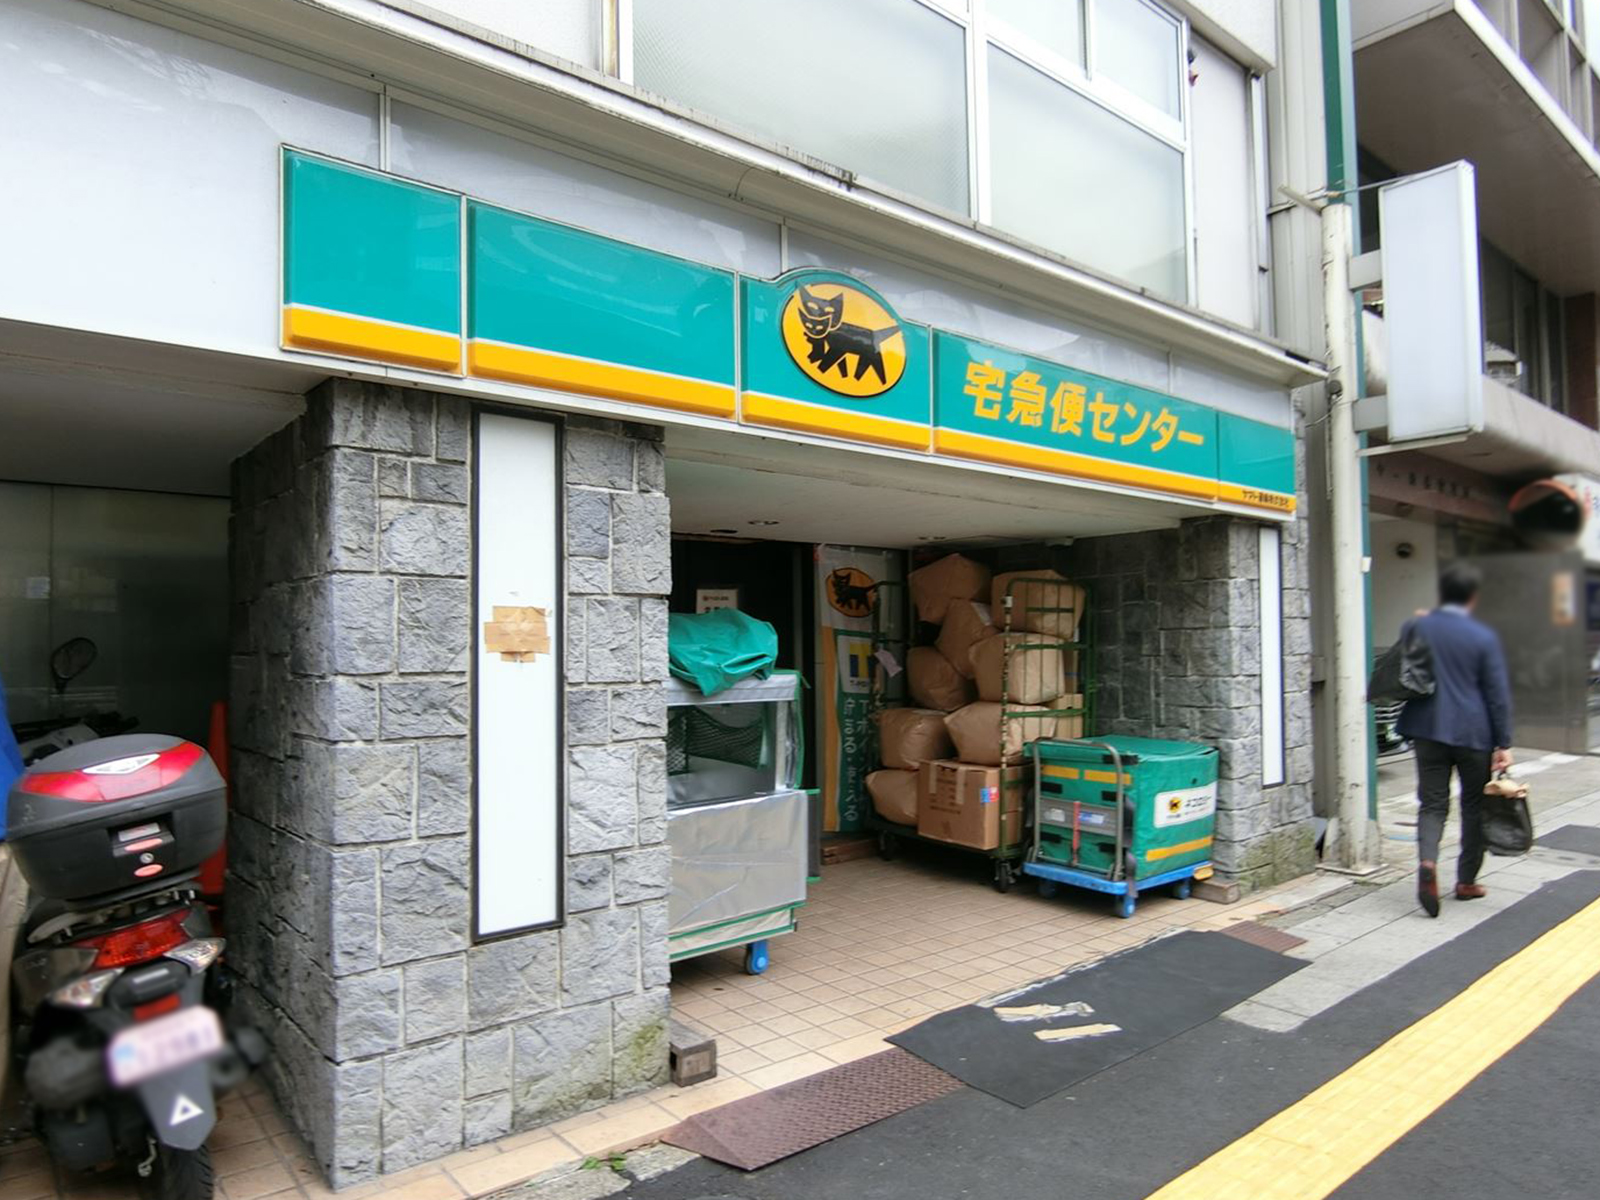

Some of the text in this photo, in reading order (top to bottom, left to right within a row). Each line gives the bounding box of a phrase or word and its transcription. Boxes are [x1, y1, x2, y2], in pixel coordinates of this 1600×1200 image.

[962, 359, 1204, 453] 宅急便センター
